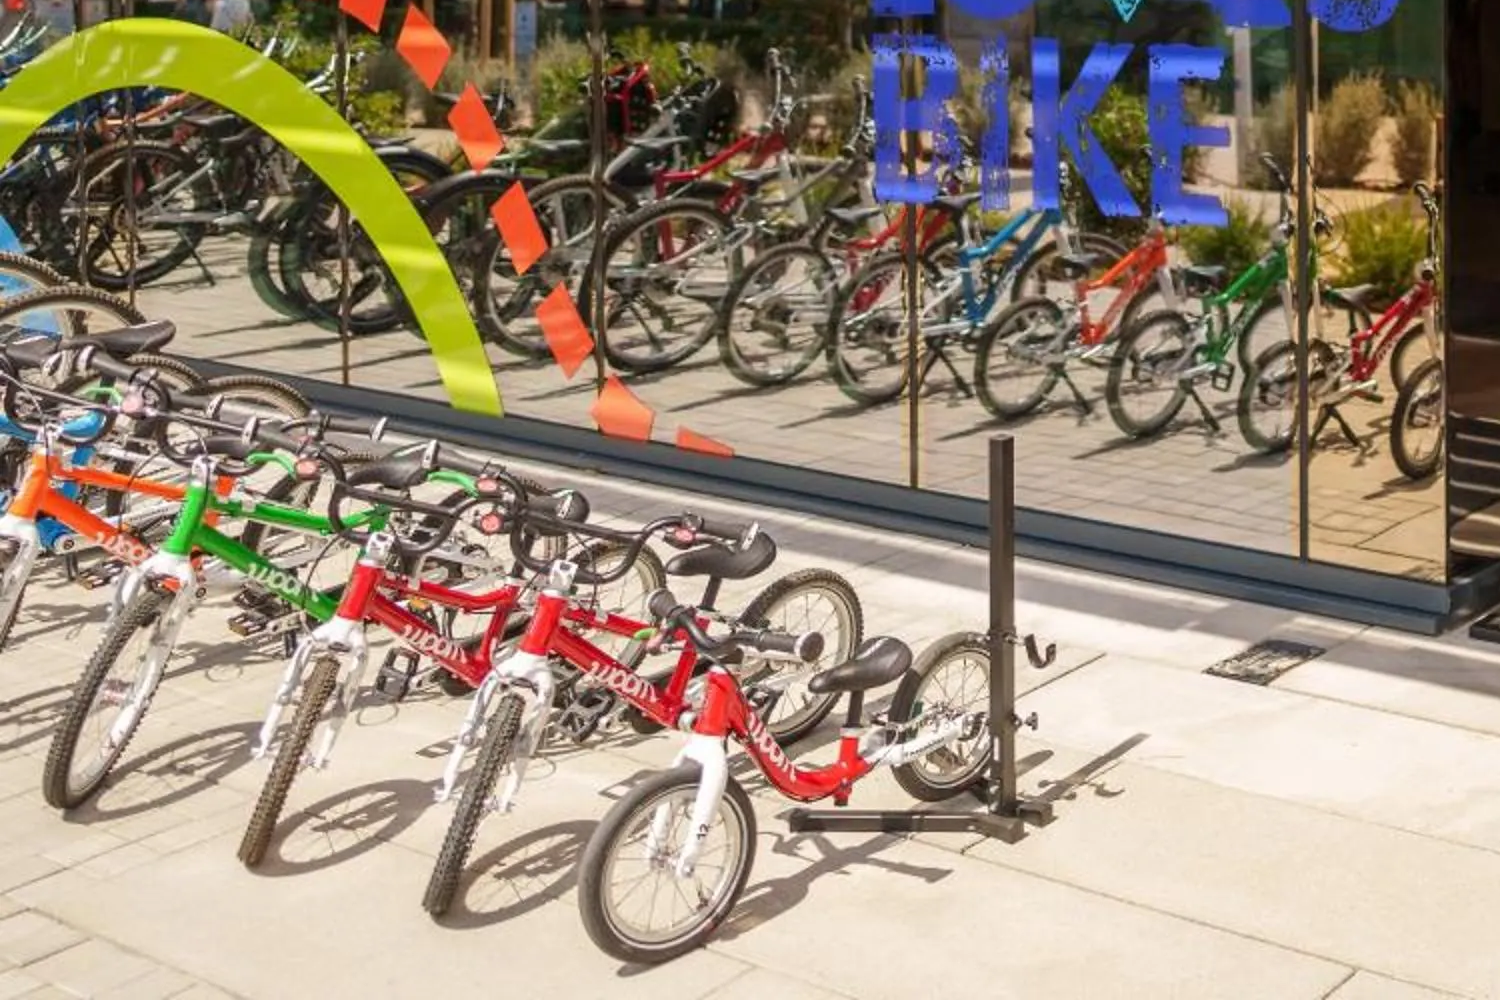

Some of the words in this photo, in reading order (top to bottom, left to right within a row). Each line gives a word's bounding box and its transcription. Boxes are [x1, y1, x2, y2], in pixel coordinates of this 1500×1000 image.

[872, 33, 1230, 228] BIKE
[402, 623, 468, 664] woom
[588, 660, 660, 703] woom
[747, 709, 799, 782] woom
